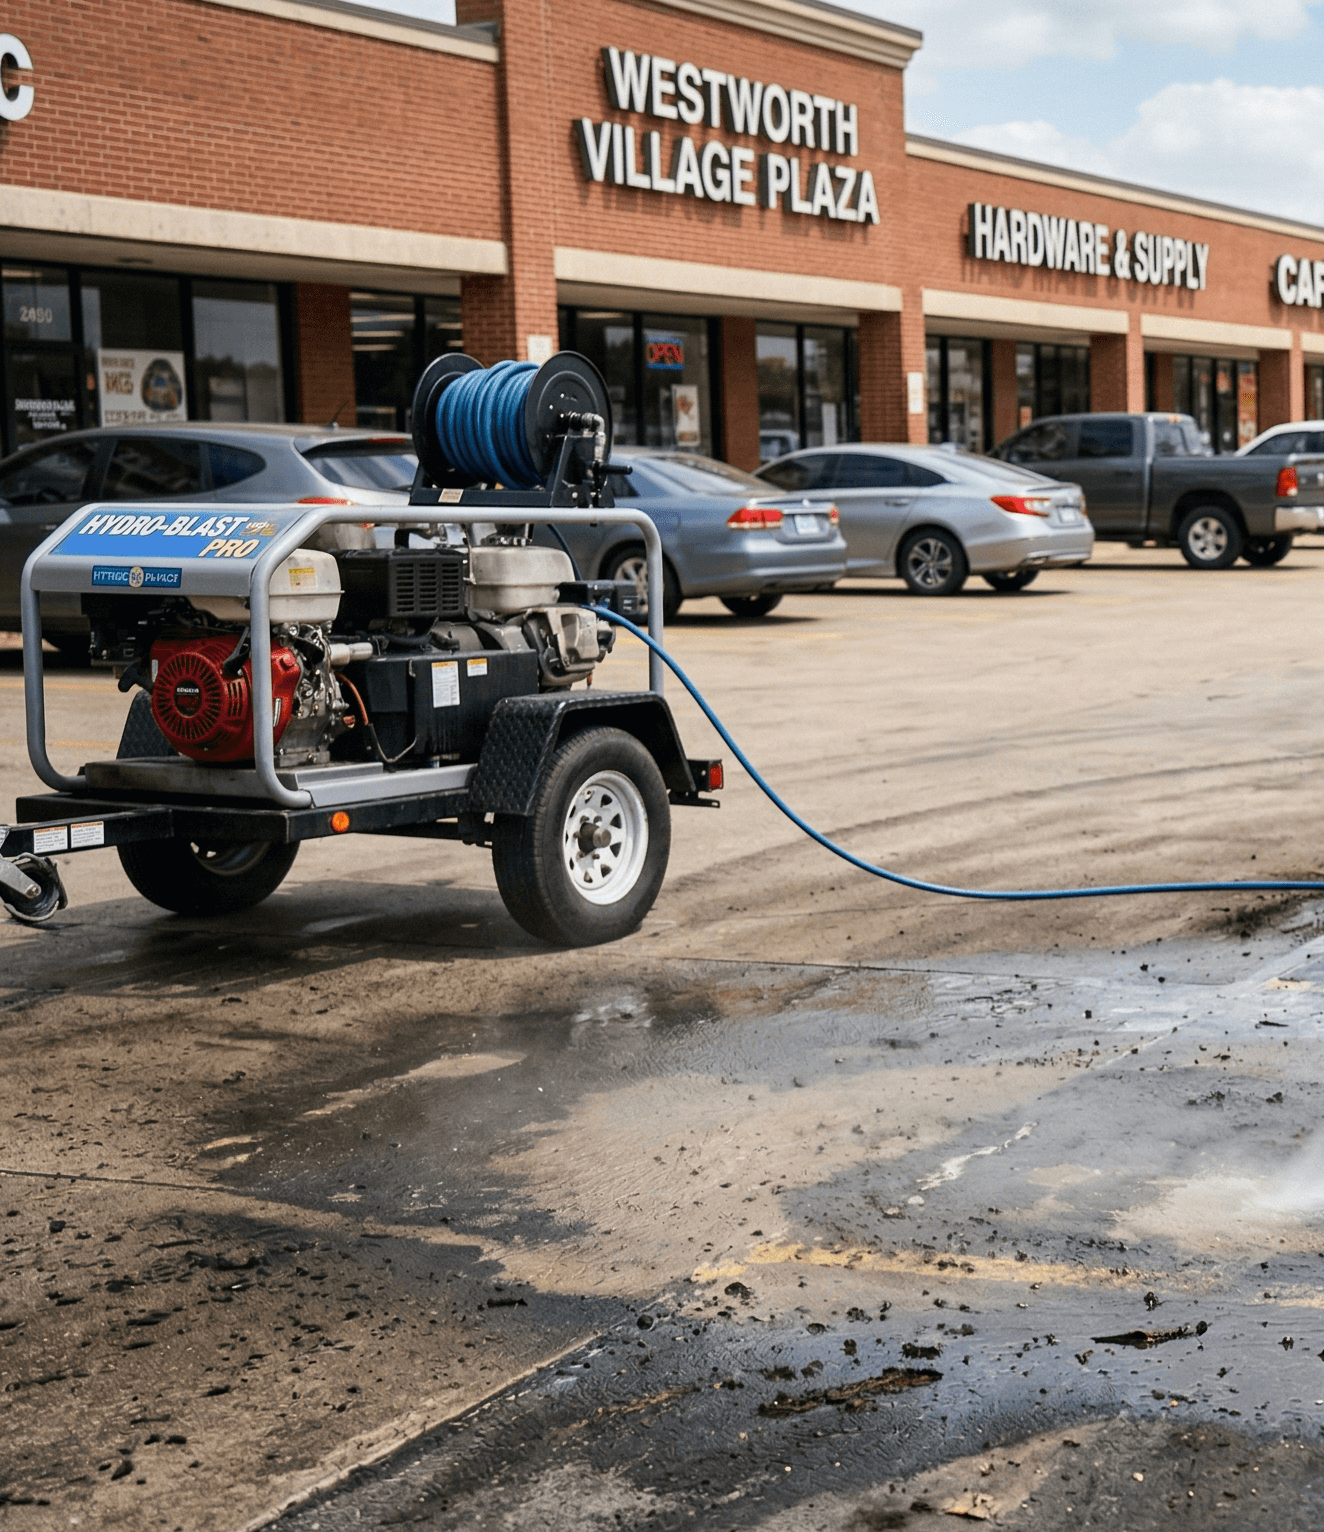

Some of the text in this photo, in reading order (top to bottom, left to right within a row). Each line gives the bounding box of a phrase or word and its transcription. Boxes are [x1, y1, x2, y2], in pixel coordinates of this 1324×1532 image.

[605, 45, 859, 157] WESTWORTH
[578, 116, 881, 226] VILLAGE PLAZA
[972, 201, 1210, 291] HARDWARE & SUPPLY
[645, 342, 685, 364] OPEN
[78, 514, 251, 537] HYDRO-BLAST
[198, 538, 260, 559] PRO
